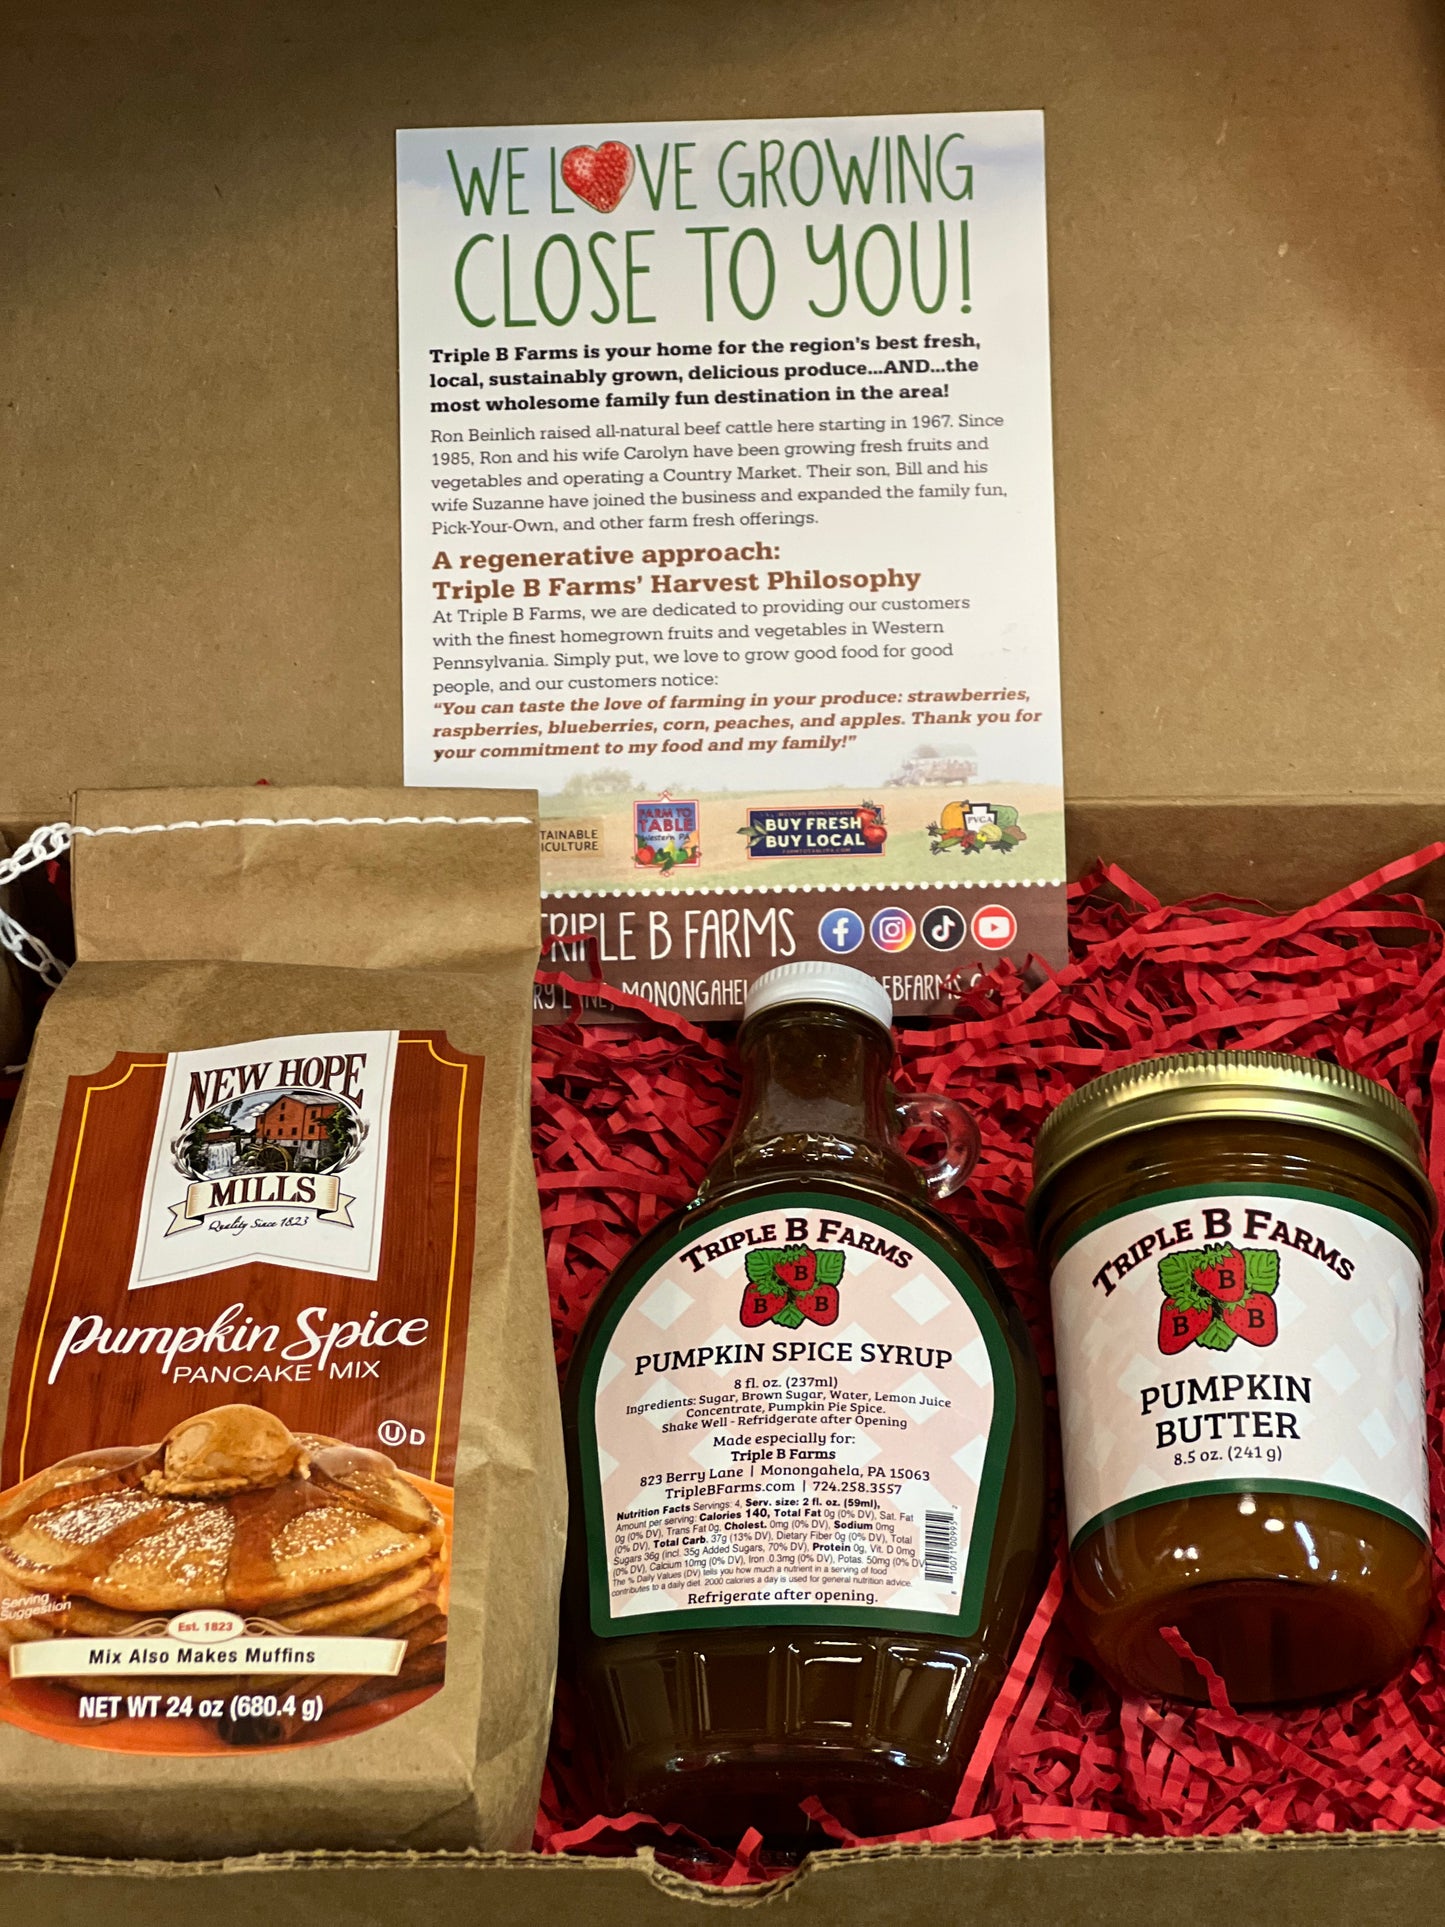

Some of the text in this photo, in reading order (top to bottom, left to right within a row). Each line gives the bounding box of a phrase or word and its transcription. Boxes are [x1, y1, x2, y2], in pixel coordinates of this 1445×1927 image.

[447, 148, 529, 216] WE
[717, 133, 974, 208] GROWING
[454, 219, 973, 328] CLOSE TO YOU!
[429, 333, 980, 365] Triple B Farms is your home for the region's best fresh,
[429, 372, 483, 389] local,
[489, 368, 607, 386] sustainably
[612, 370, 682, 385] grown,
[688, 364, 778, 379] delicious
[430, 414, 1003, 442] Ron Beinlich raised all-natural beef cattle here starting in 1967. Since
[432, 541, 779, 573] A regenerative approach:
[432, 579, 514, 603] Triple
[523, 578, 540, 597] B
[650, 573, 759, 593] Harvest
[767, 568, 920, 592] Philosophy
[432, 708, 1042, 739] raspberries, blueberries, corn, peaches, and apples. Thank you for
[638, 807, 692, 819] FARM TO
[766, 817, 862, 831] BUY FRESH
[640, 819, 693, 833] TABLE
[766, 834, 865, 848] BUY LOCAL
[650, 911, 672, 960] B
[685, 908, 796, 959] FARMS
[181, 1053, 367, 1129] NEW HOPE
[208, 1175, 315, 1209] MILLS
[209, 1215, 309, 1236] Quality Since 1823
[785, 1217, 809, 1242] B
[1204, 1208, 1233, 1240] B
[280, 1305, 429, 1371] Spice
[634, 1342, 951, 1375] PUMPKIN SPICE SYRUP
[172, 1360, 381, 1385] PANCAKE MIX
[734, 1376, 837, 1389] 8 fl. oz. (237ml)
[626, 1390, 950, 1414] Ingredients: Sugar, Brown Sugar, Water, Lemon Juice
[1140, 1373, 1312, 1416] PUMPKIN
[686, 1401, 885, 1417] Concentrate, Pumpkin Pie Spice.
[662, 1413, 906, 1433] Shake Well Refridgerate after Opening
[1156, 1410, 1301, 1449] BUTTER
[713, 1432, 855, 1446] Made especially for:
[730, 1448, 835, 1463] Triple B Farms
[1173, 1446, 1283, 1466] 8.5 oz. (241 g)
[640, 1464, 929, 1486] 823 Berry Lane Monongahela, PA 15063
[665, 1481, 901, 1500] TripleBFarms.com 724.258.3557
[616, 1508, 659, 1520] Nutrition
[662, 1504, 690, 1514] Facts
[693, 1502, 729, 1511] Servings:
[745, 1498, 771, 1506] Serv.
[775, 1497, 798, 1505] size:
[802, 1497, 808, 1505] 2
[812, 1497, 821, 1505] fl.
[687, 1588, 877, 1604] Refrigerate after opening.
[0, 1600, 72, 1620] Suggestion
[178, 1622, 233, 1632] Est. 1823
[89, 1647, 316, 1664] Mix Also Makes Muffins
[78, 1695, 324, 1721] NET WT 24 oz (680.4 g)
